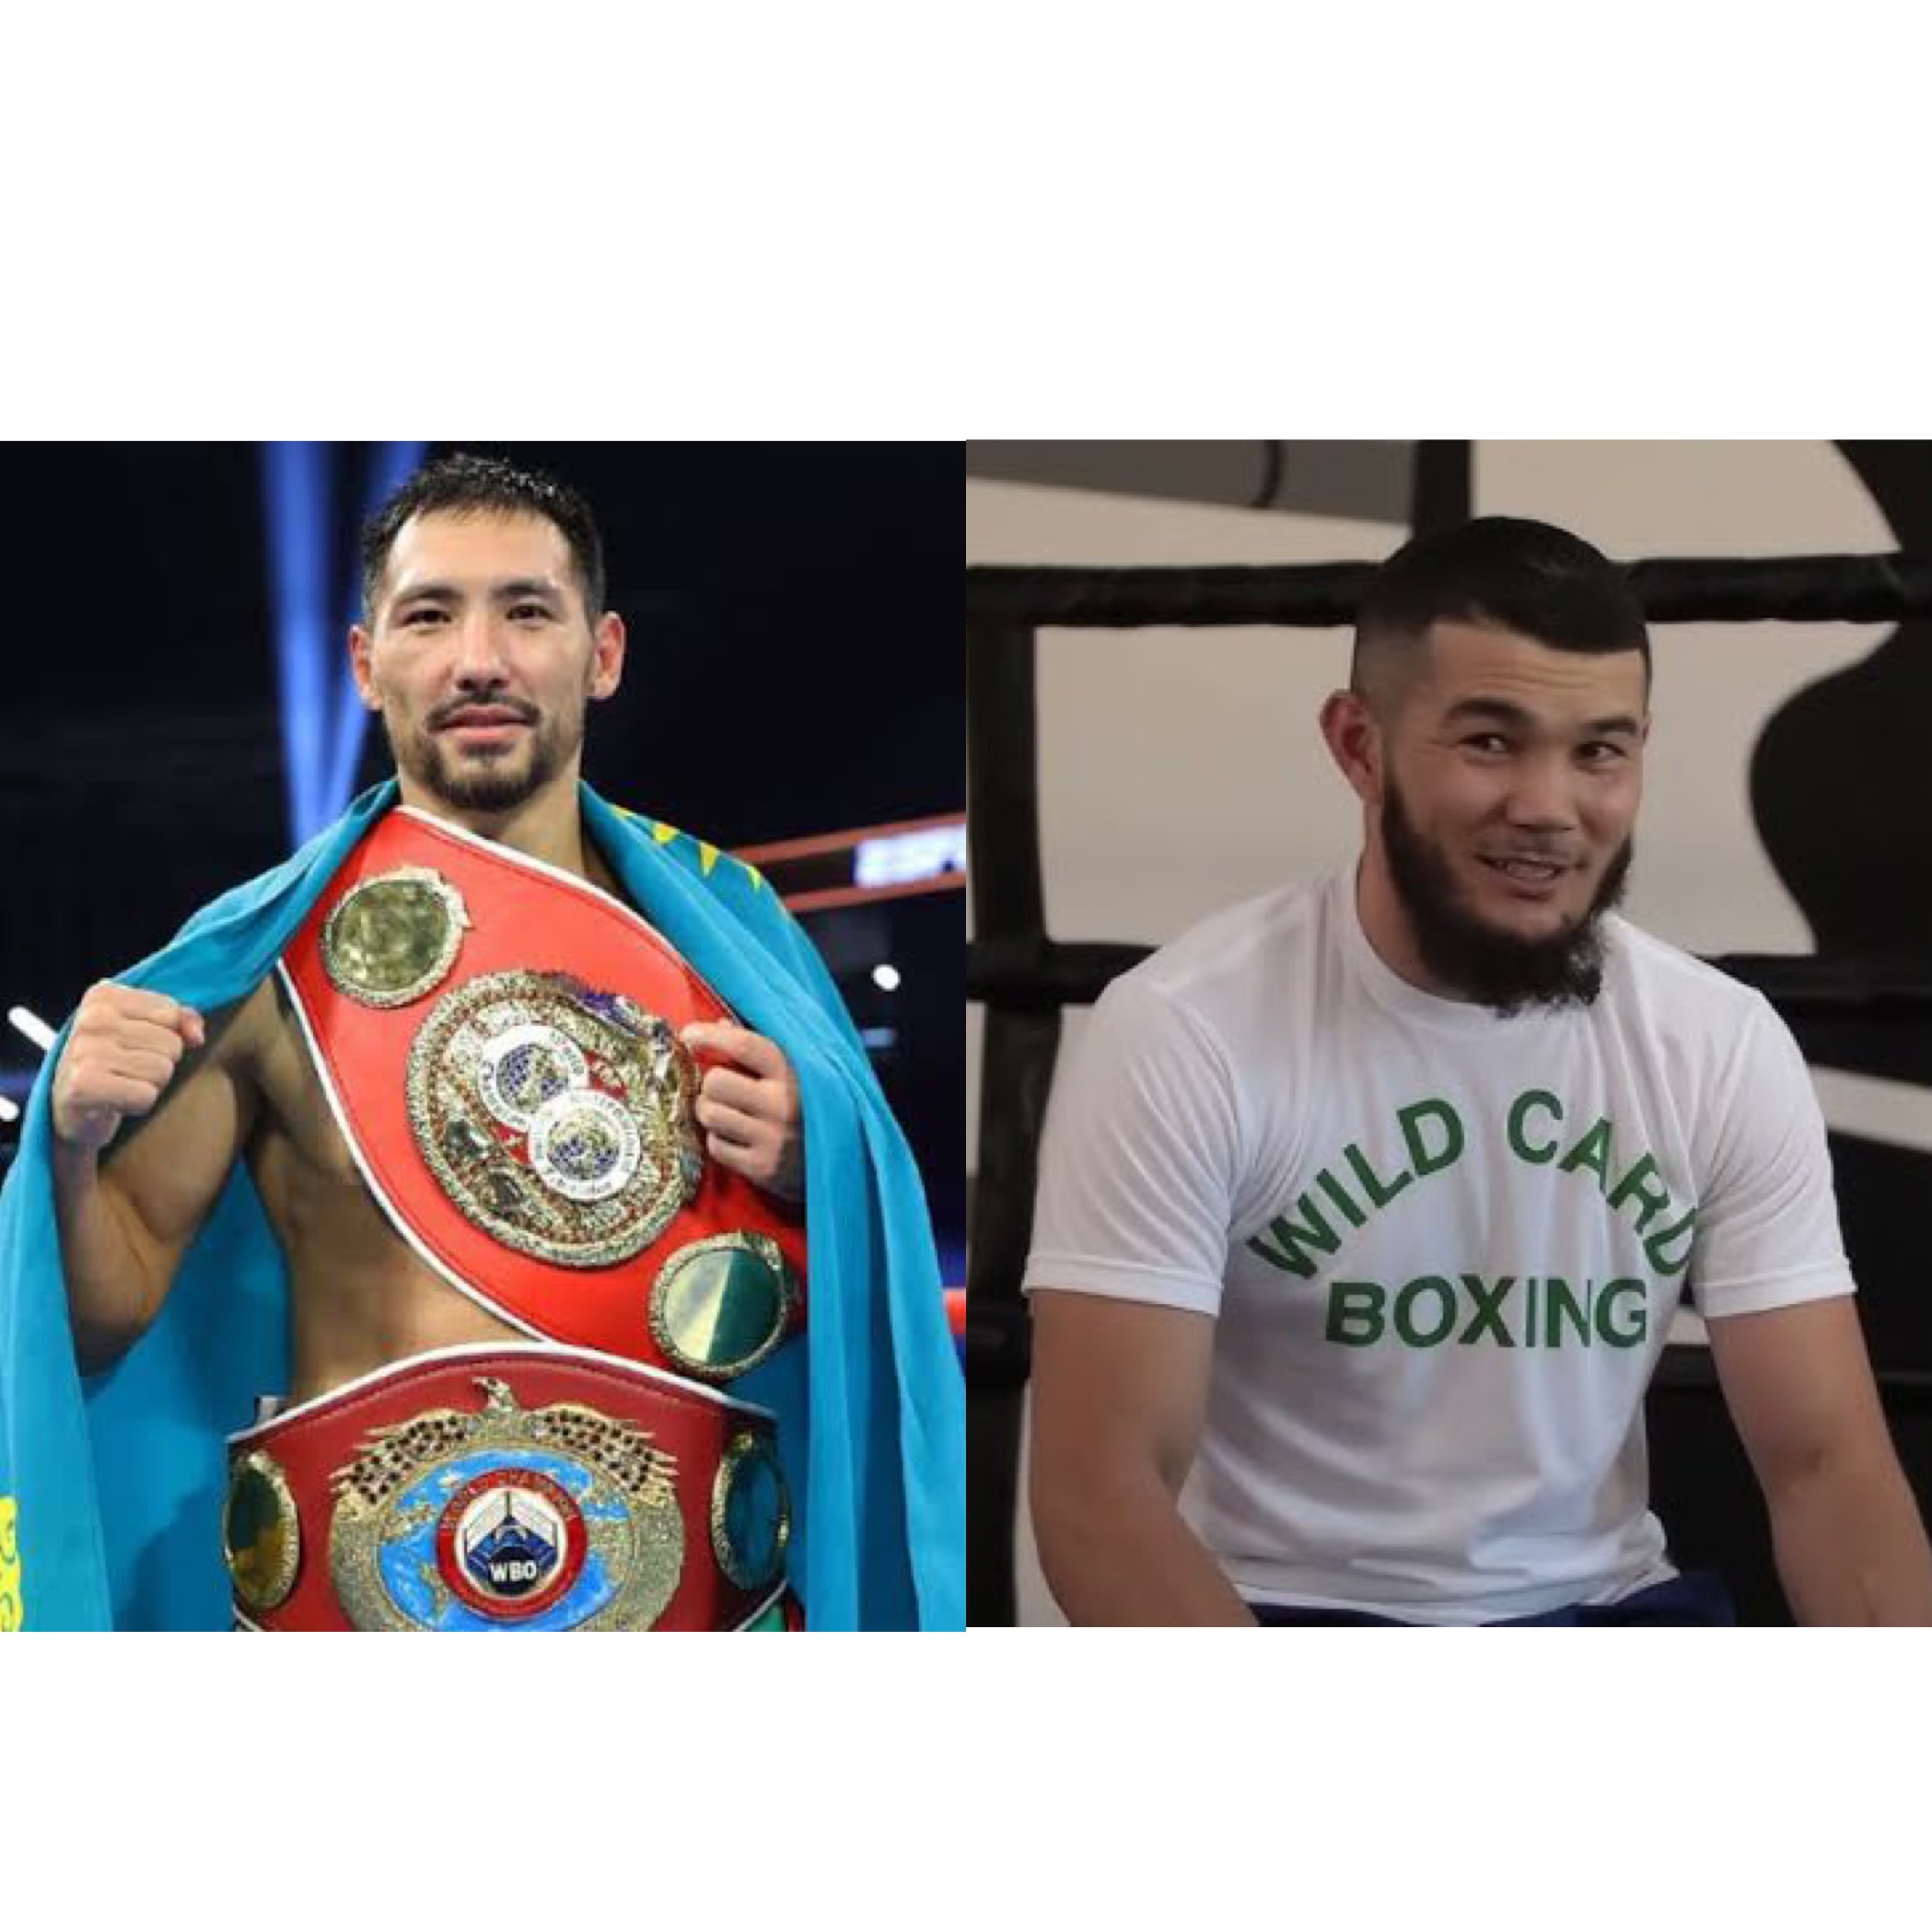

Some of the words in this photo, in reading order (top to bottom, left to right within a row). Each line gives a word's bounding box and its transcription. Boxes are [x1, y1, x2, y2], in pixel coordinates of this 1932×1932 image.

[1246, 1097, 1465, 1279] WILD
[1506, 1088, 1697, 1276] CARD
[1325, 1274, 1647, 1349] BOXING
[489, 1559, 538, 1582] WBO
